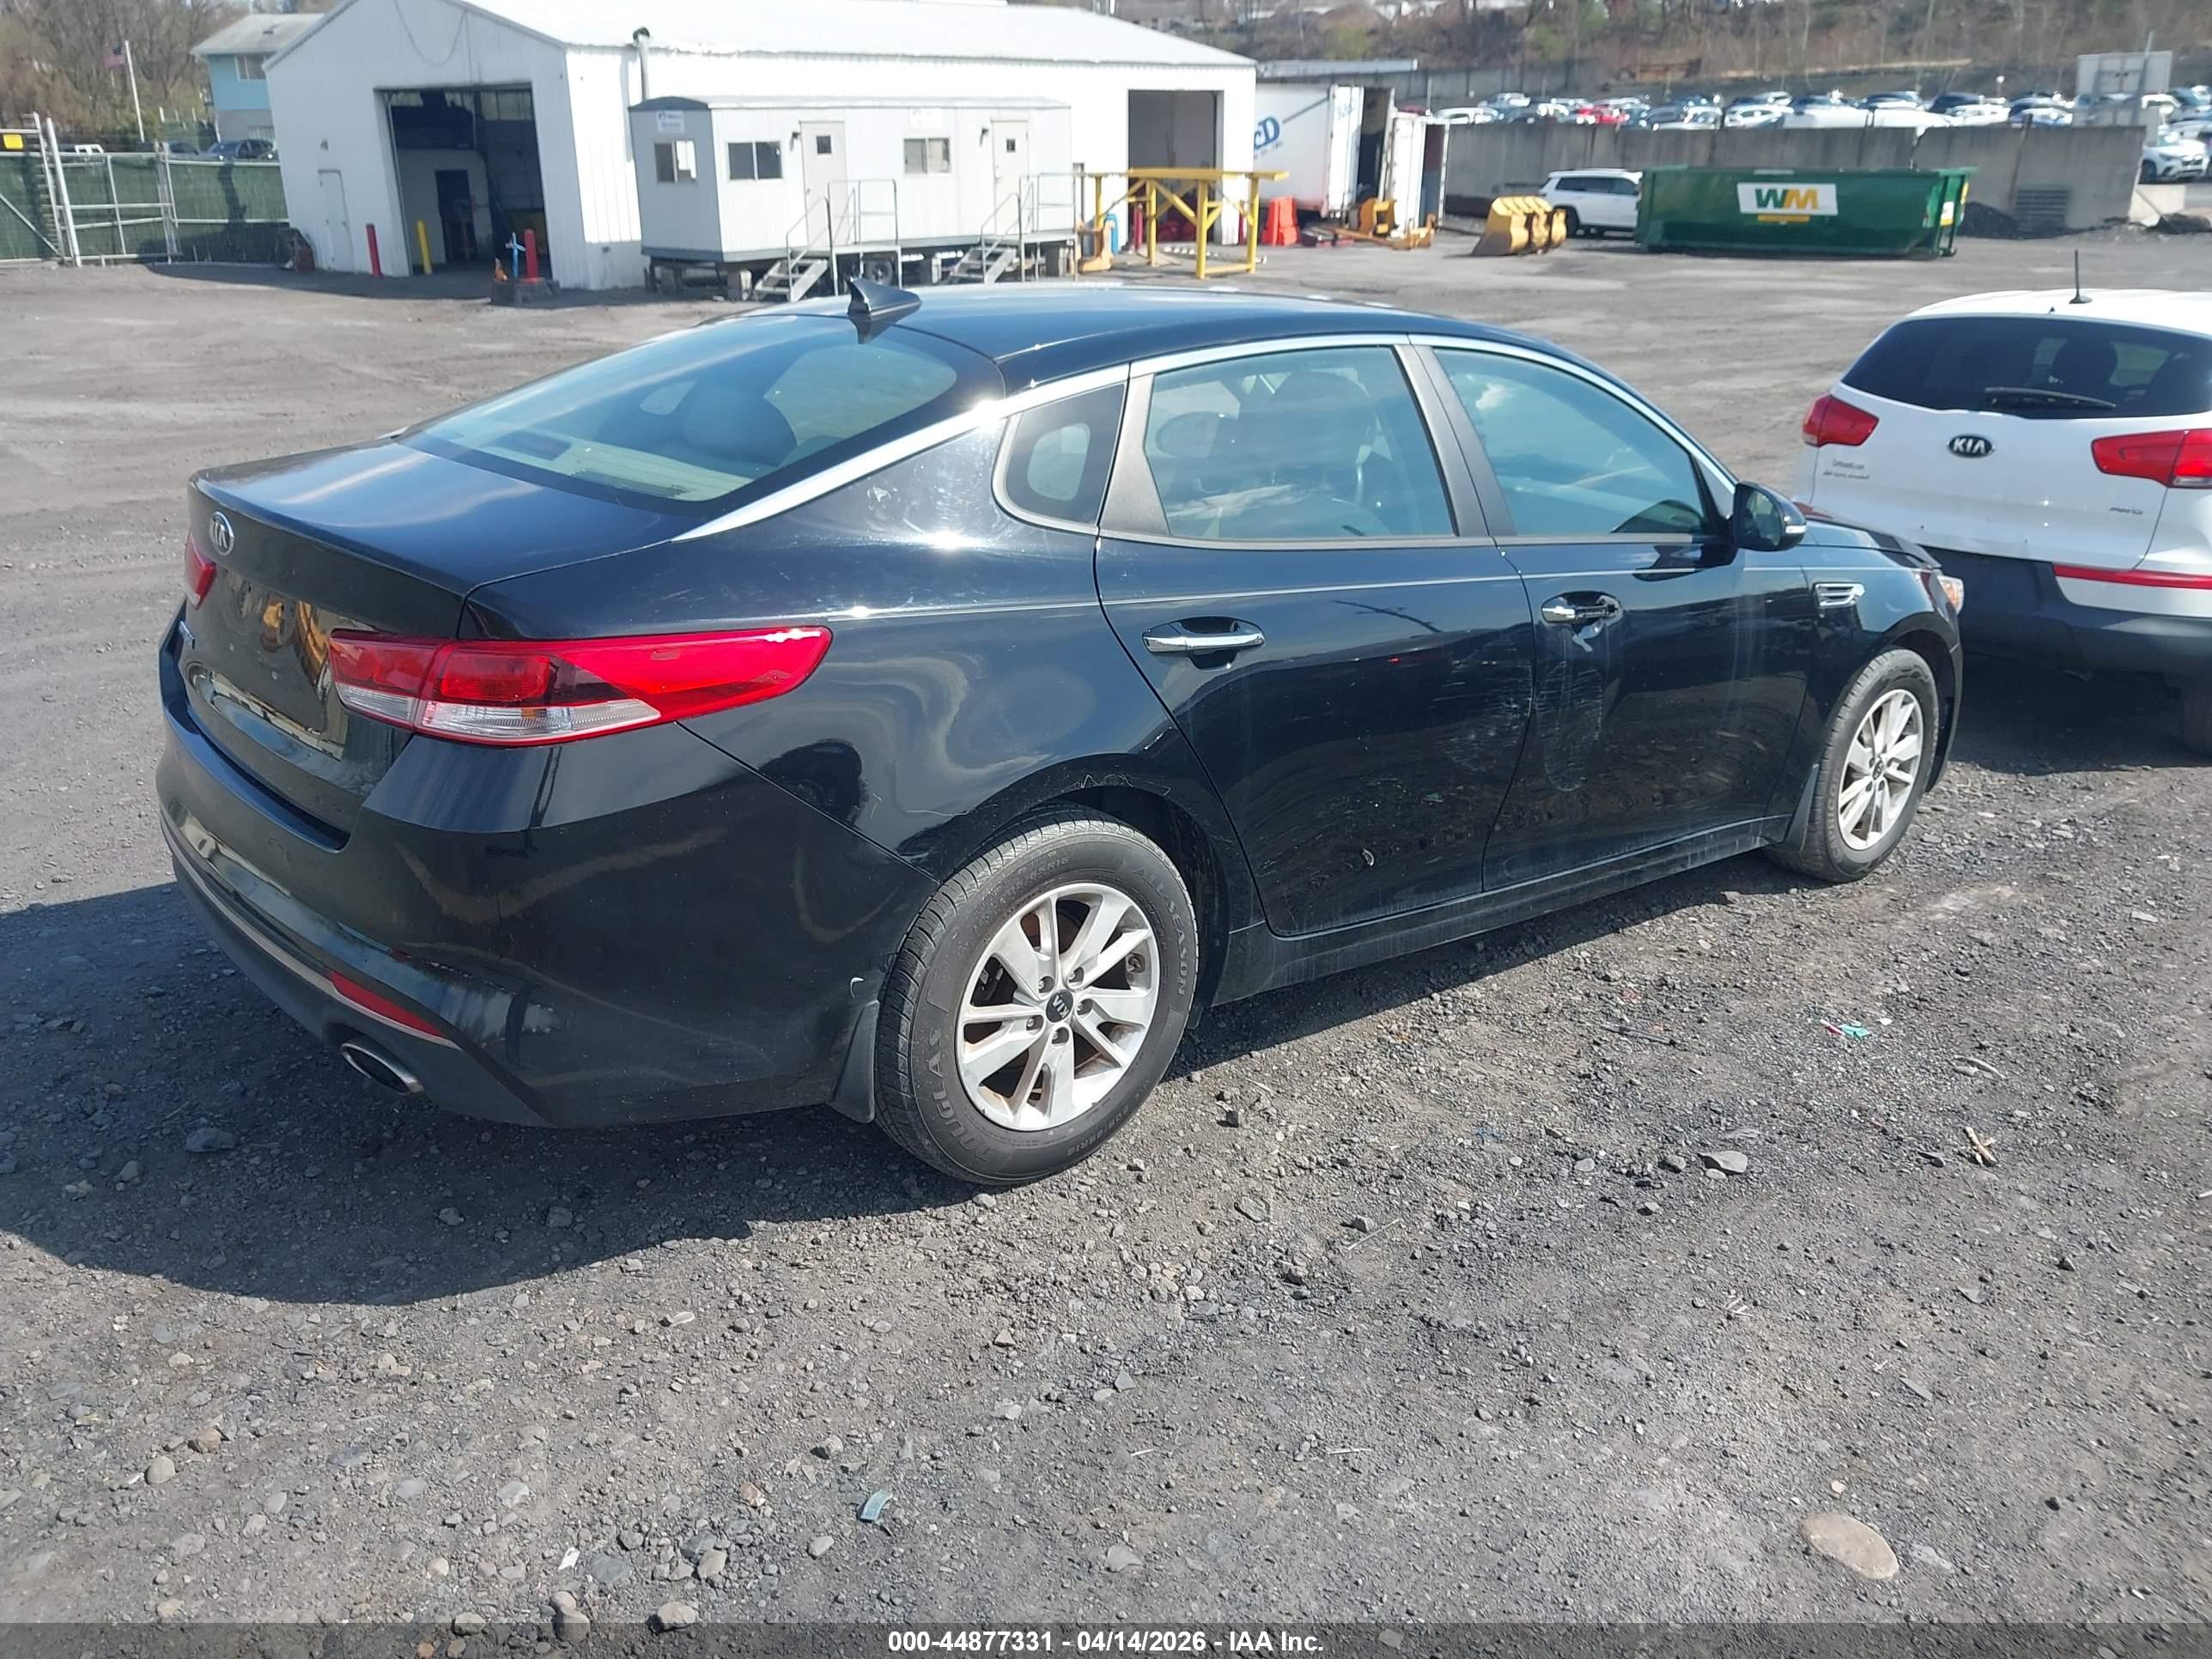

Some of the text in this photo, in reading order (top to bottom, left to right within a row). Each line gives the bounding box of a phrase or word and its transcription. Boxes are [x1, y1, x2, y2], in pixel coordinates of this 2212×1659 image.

[1755, 188, 1818, 210] WM
[1954, 438, 1985, 454] KIA
[1133, 868, 1188, 995] ALL-SEASON
[1053, 994, 1070, 1019] KIA
